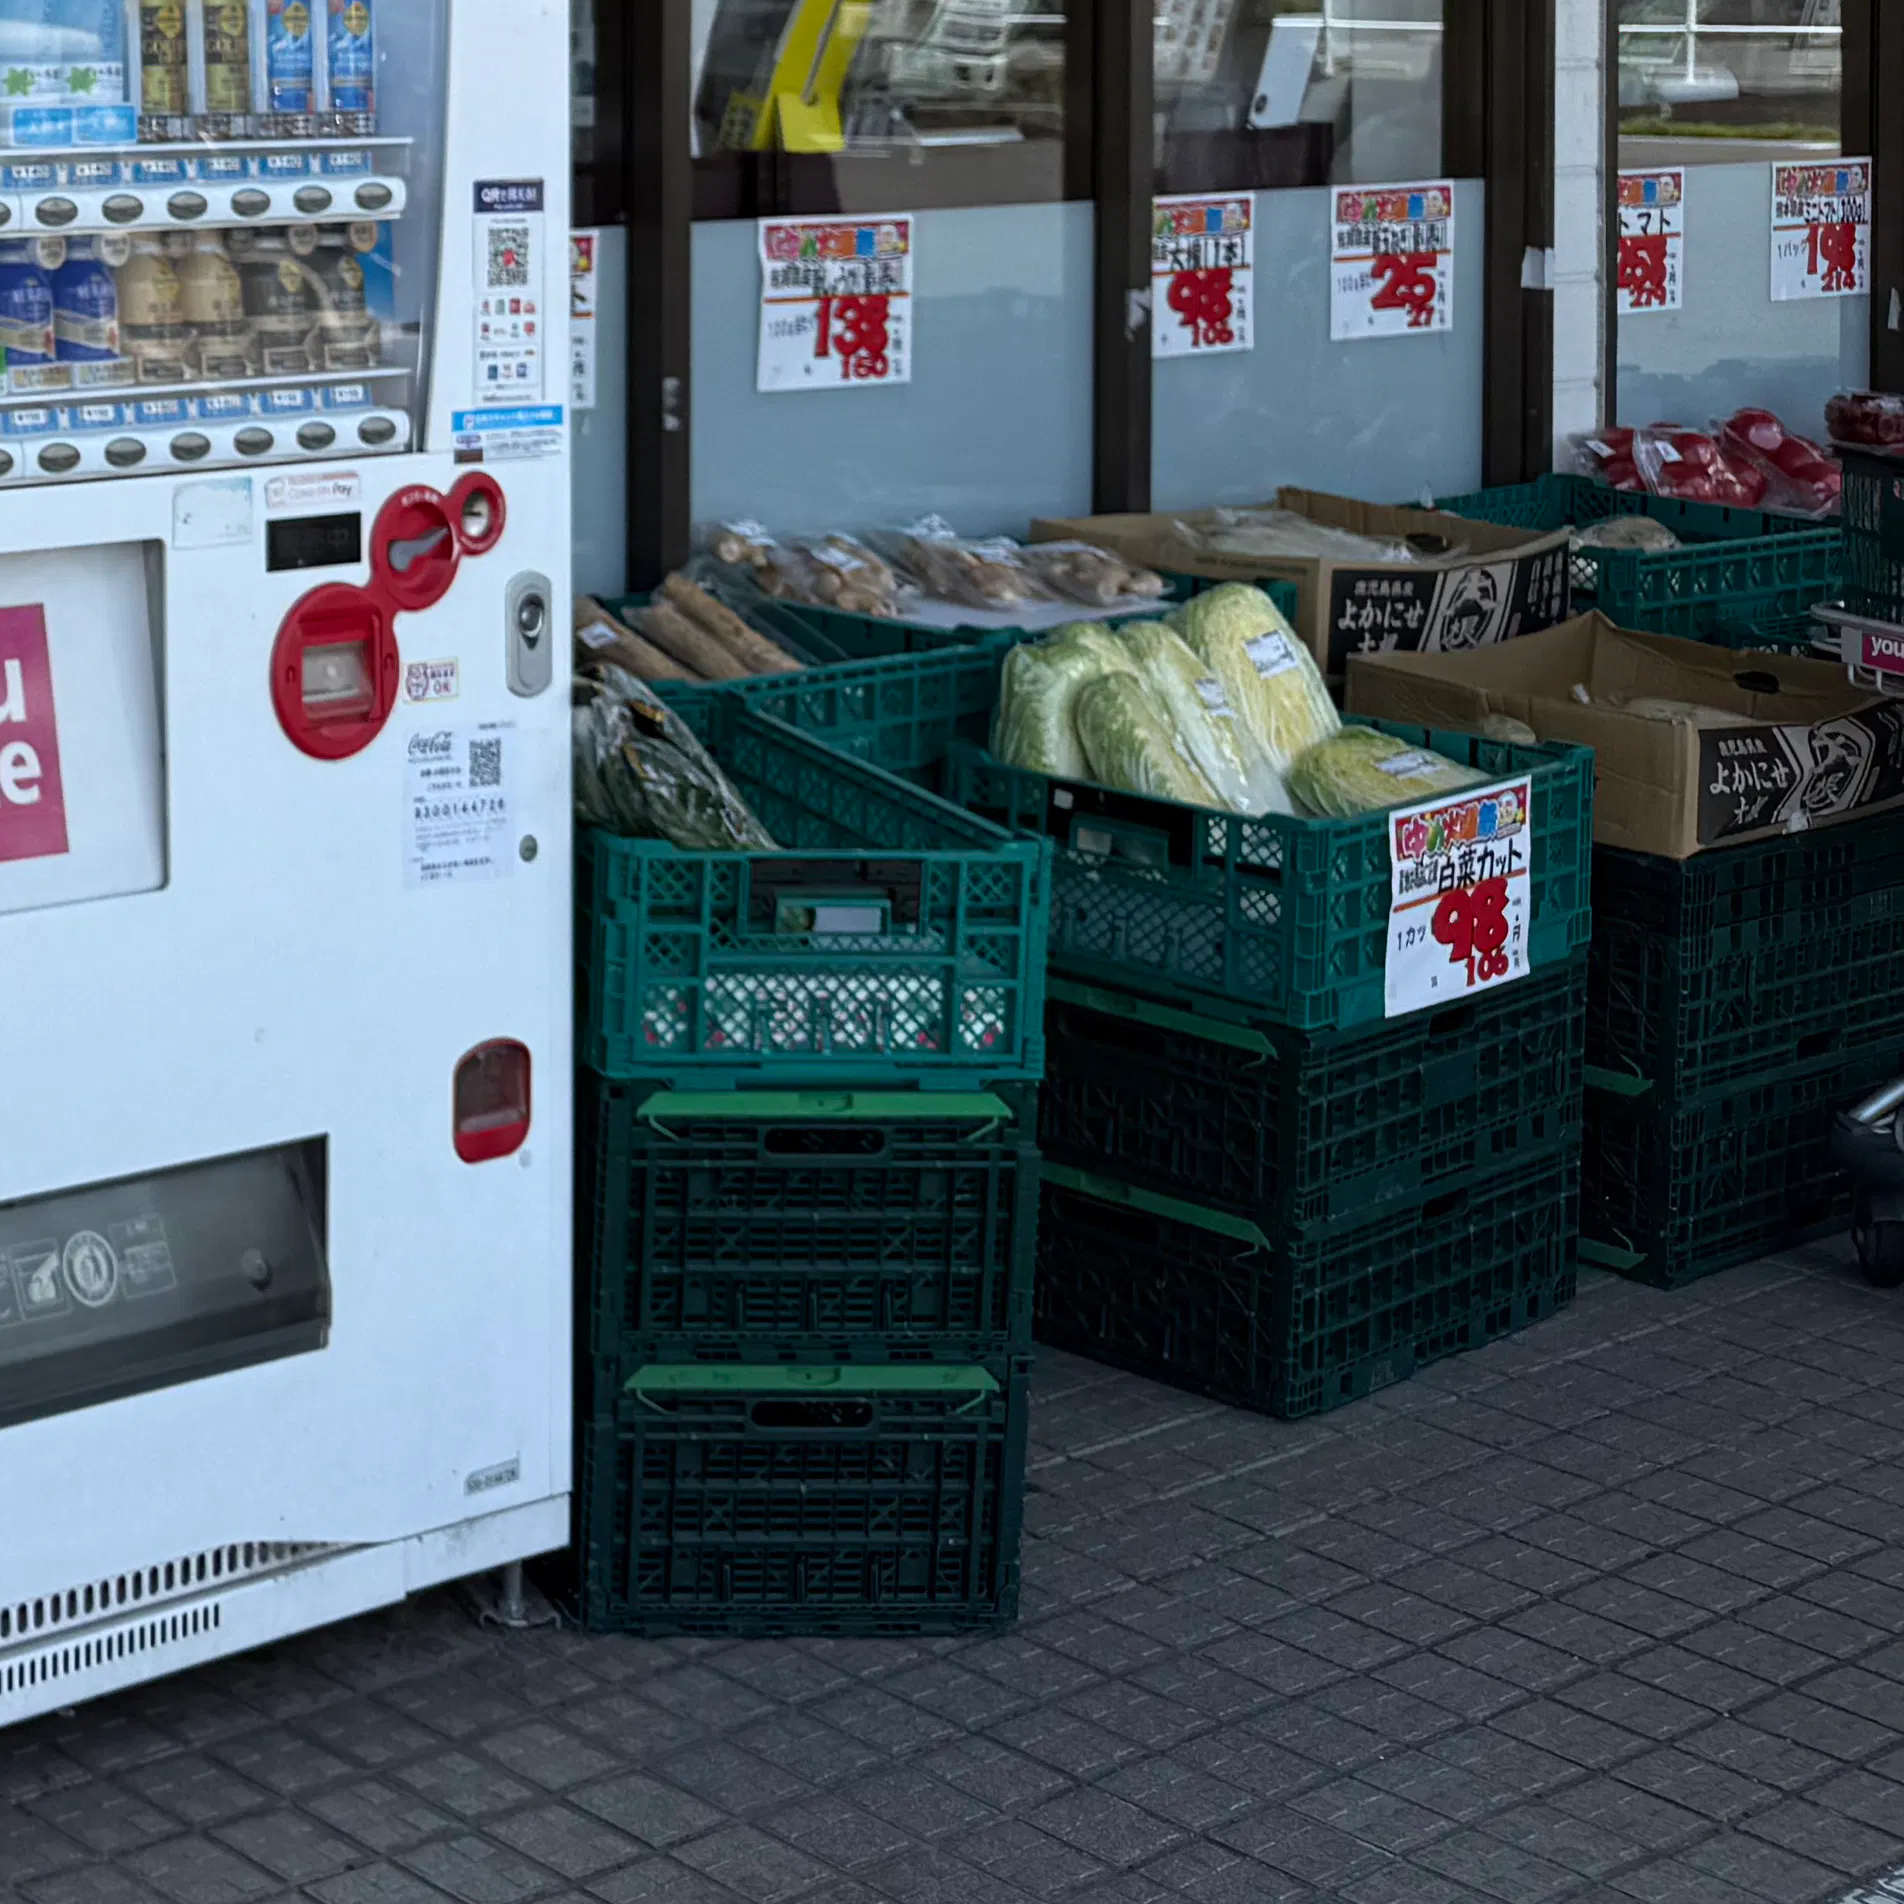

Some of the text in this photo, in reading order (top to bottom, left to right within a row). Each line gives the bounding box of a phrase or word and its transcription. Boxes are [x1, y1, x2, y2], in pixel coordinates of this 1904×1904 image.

[1805, 224, 1857, 275] 198
[1370, 251, 1438, 311] 25
[1820, 268, 1857, 292] 214
[1338, 598, 1424, 631] よかにせ
[1709, 757, 1790, 795] よかにせ
[1437, 837, 1523, 895] 白菜カット
[1431, 876, 1509, 964] 98
[1465, 946, 1509, 987] 106
